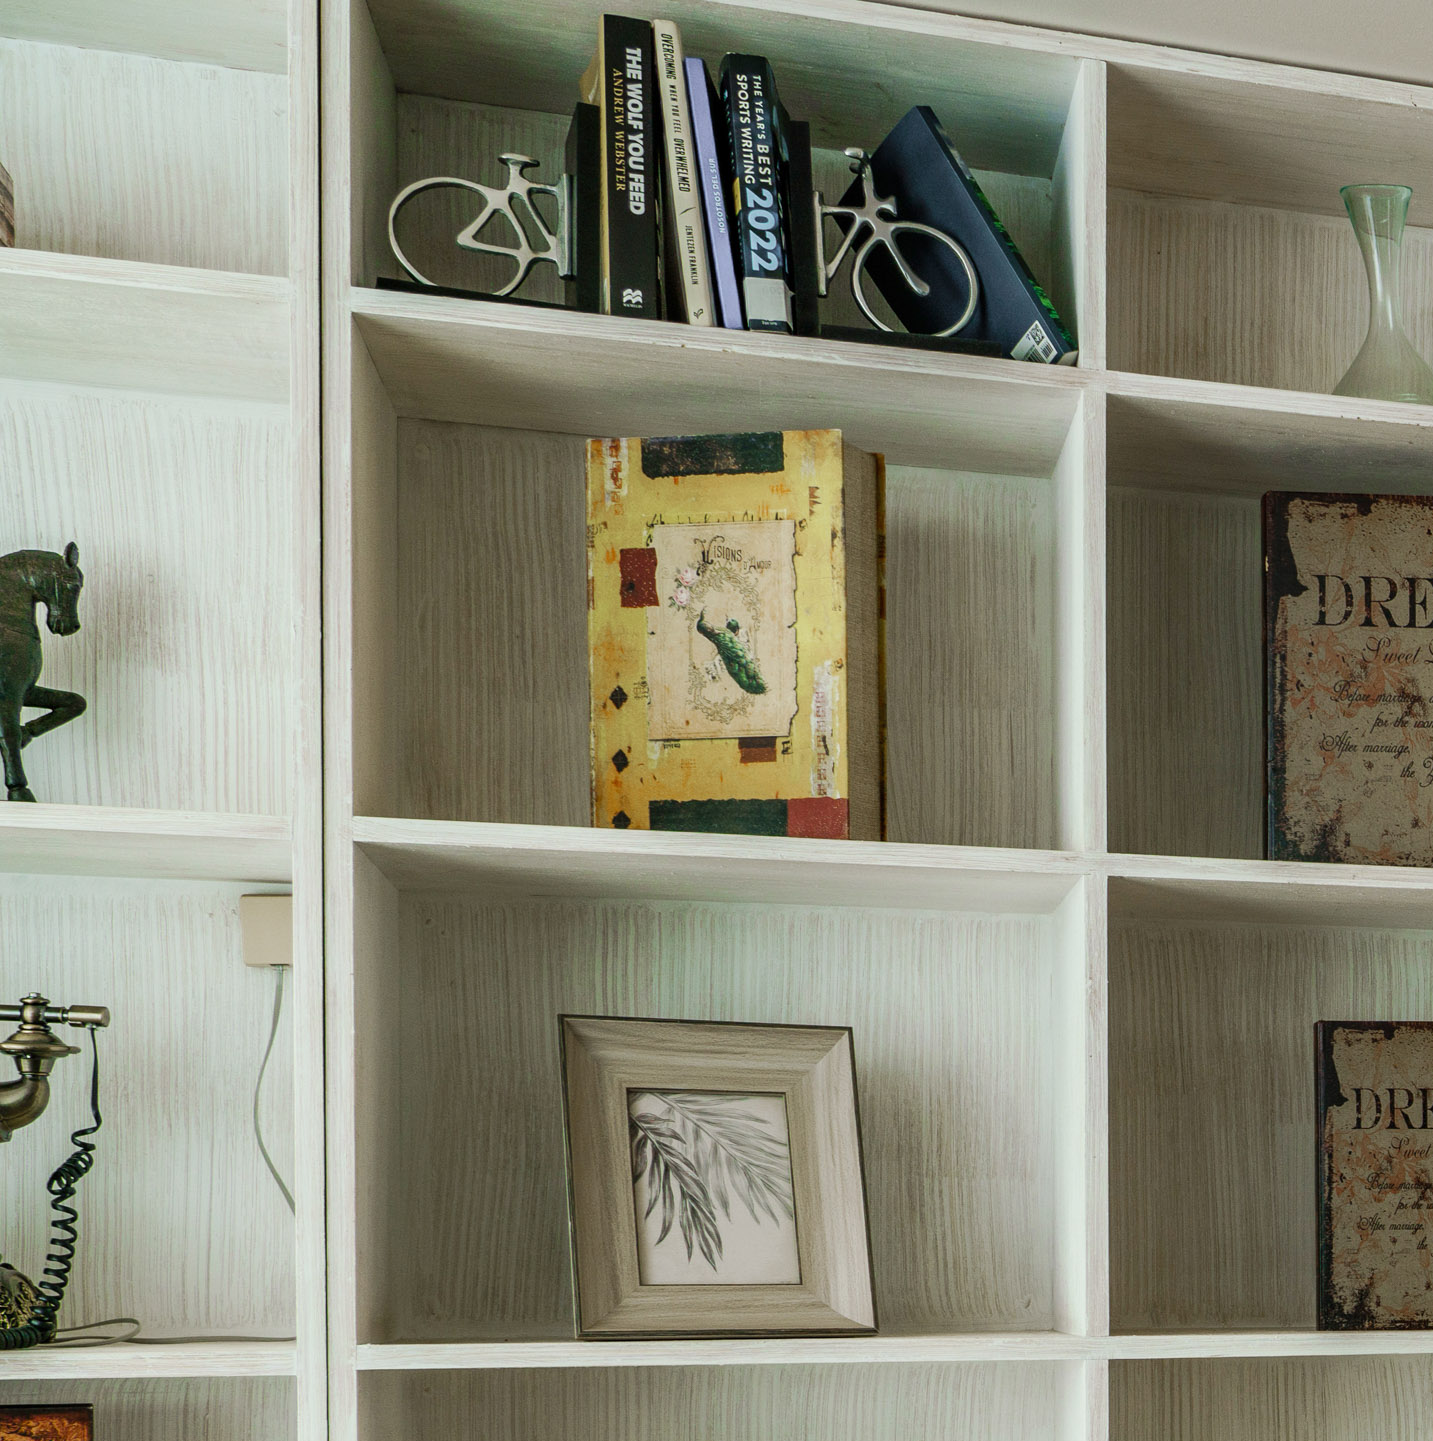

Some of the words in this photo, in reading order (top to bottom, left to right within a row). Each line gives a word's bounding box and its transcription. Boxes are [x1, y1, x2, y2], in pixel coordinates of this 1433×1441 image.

[625, 48, 642, 80] THE
[661, 33, 677, 80] OVERCOMING
[612, 68, 624, 125] ANDREW
[668, 85, 678, 101] WHEN
[736, 74, 751, 124] SPORTS
[752, 75, 763, 97] THE
[627, 83, 643, 129] WOLF
[671, 105, 680, 116] YOU
[754, 101, 766, 140] YEAR'S
[673, 119, 682, 134] FEEL
[614, 131, 626, 191] WEBSTER
[628, 133, 644, 169] YOU
[674, 138, 691, 192] OVERWHELMED
[708, 158, 717, 173] SUR
[741, 128, 755, 185] WRITING
[757, 144, 772, 186] BEST
[629, 173, 646, 215] FEED
[711, 175, 720, 189] DEL
[713, 191, 726, 234] NOSOTROS
[745, 187, 779, 271] 2022
[685, 225, 696, 254] JENTEZEN
[688, 255, 699, 285] FRANKLIN
[1330, 680, 1370, 707] Before
[1370, 711, 1389, 733] for
[1393, 715, 1409, 728] the
[1320, 731, 1359, 758] After
[1400, 761, 1415, 778] the
